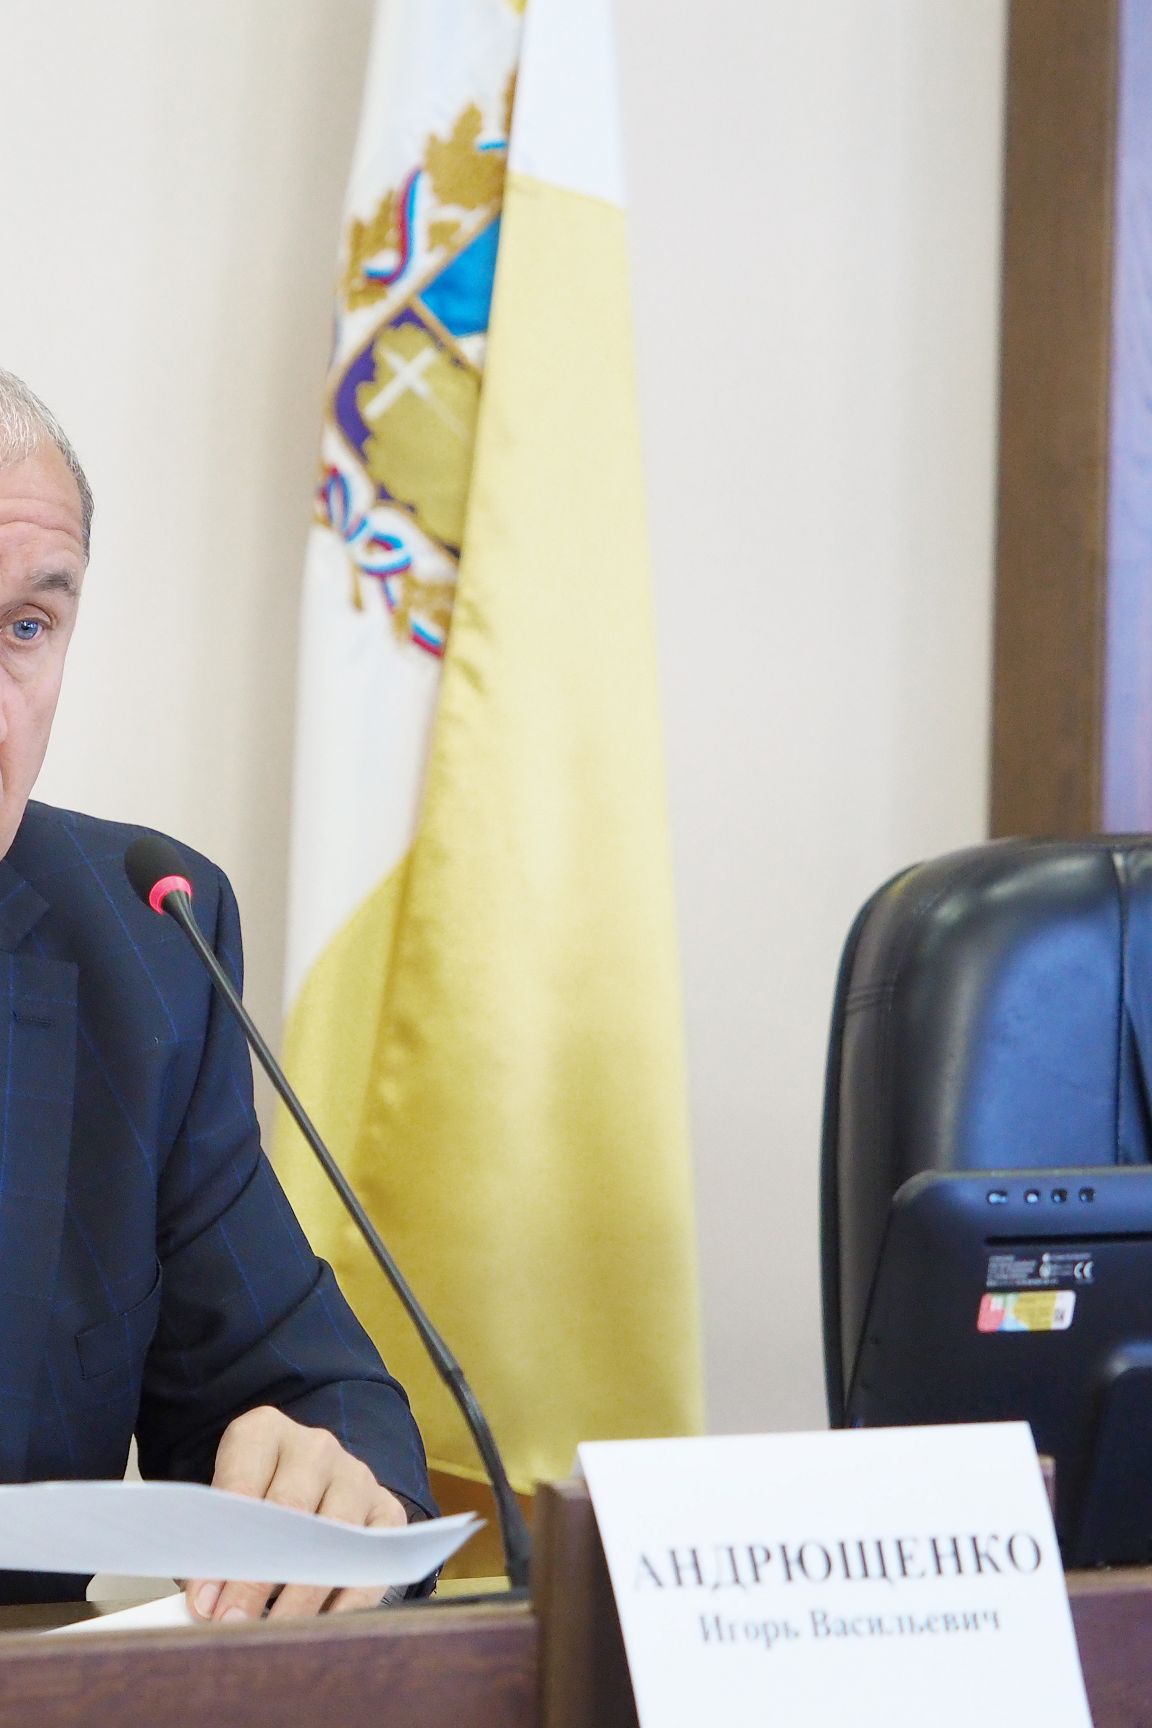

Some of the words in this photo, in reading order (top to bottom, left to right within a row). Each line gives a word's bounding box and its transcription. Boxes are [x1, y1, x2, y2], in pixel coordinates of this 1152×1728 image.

[635, 1531, 1043, 1591] АНДРЮЩЕНКО
[699, 1611, 799, 1649] Игорь
[811, 1607, 1000, 1639] Васильевич
